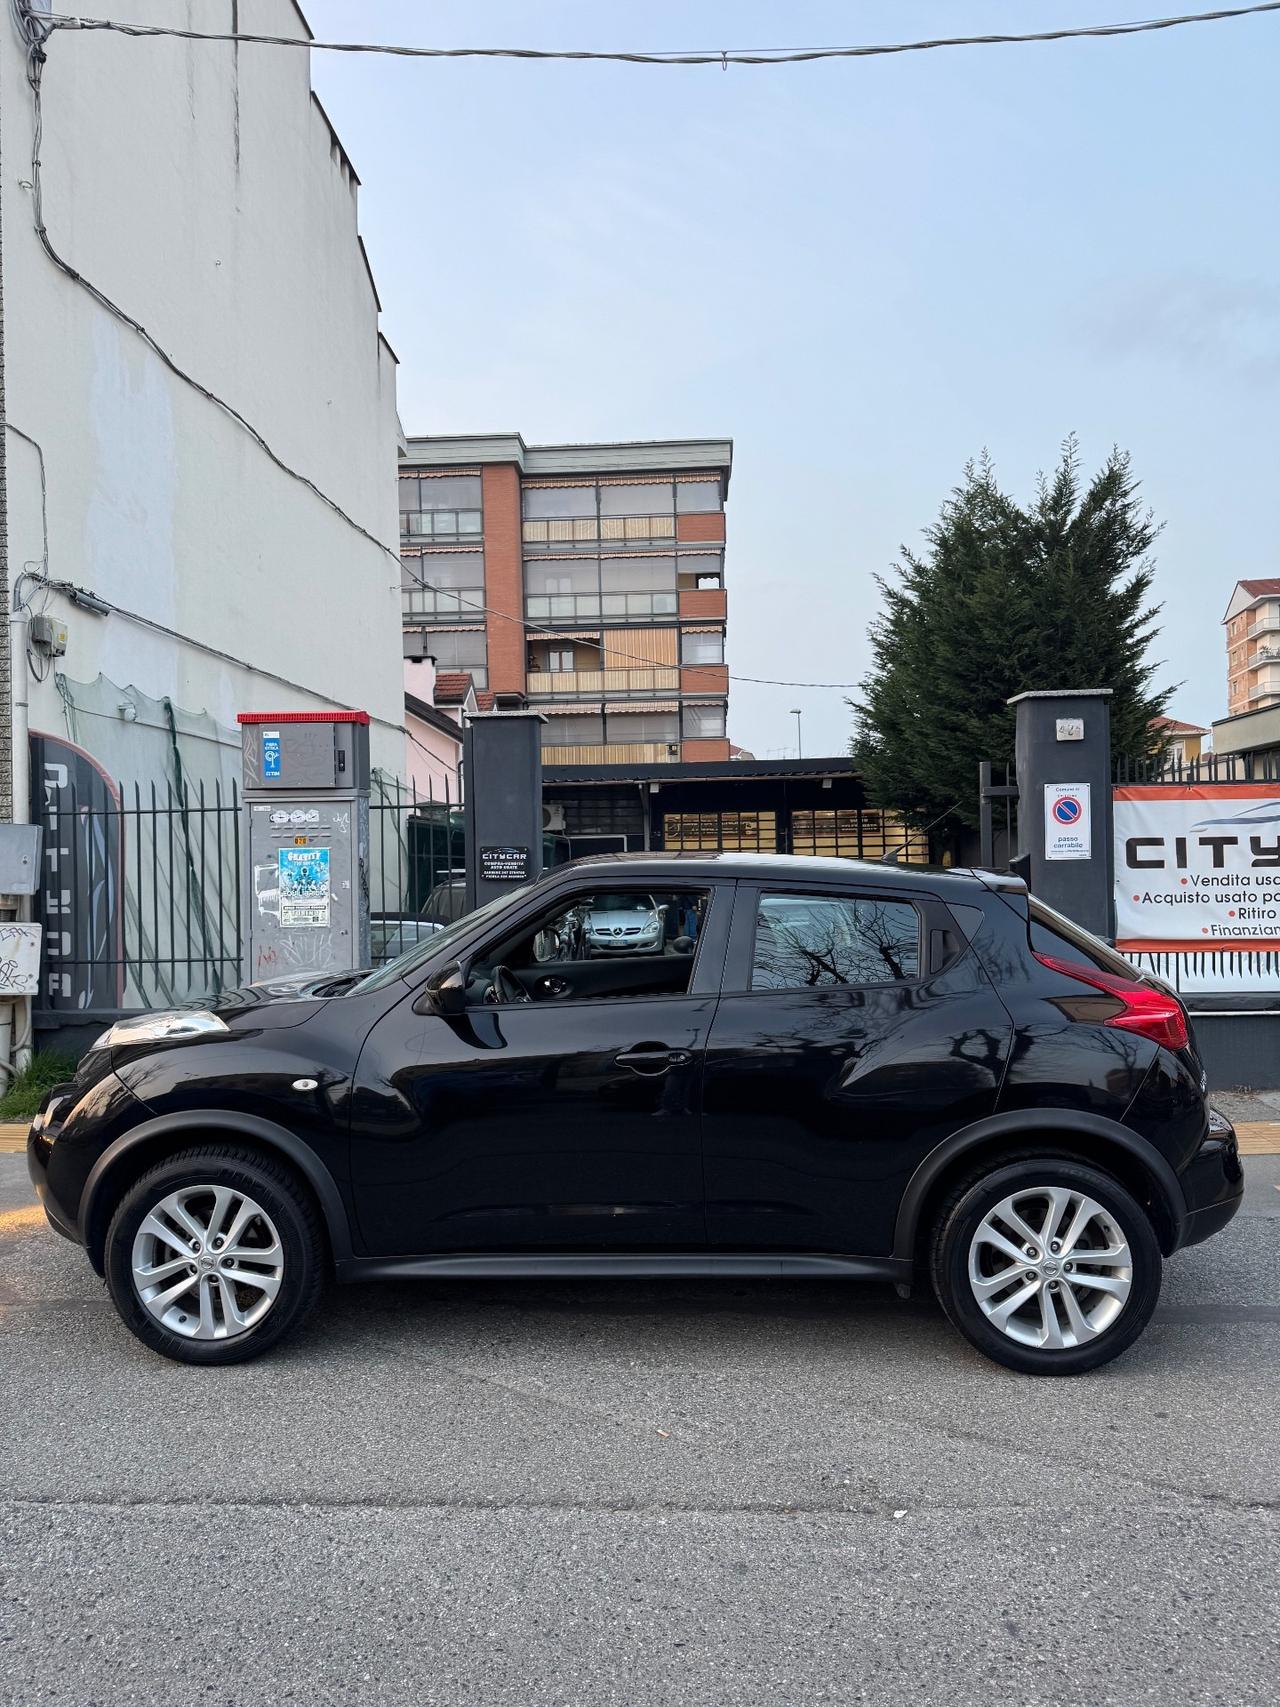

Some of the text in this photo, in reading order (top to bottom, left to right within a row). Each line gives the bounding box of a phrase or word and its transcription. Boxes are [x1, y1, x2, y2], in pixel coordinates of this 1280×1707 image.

[1125, 836, 1280, 869] CITY
[1190, 874, 1250, 886] Vendita
[1142, 891, 1211, 906] Acquisto
[1215, 890, 1257, 903] usato
[1238, 907, 1277, 919] Ritiro
